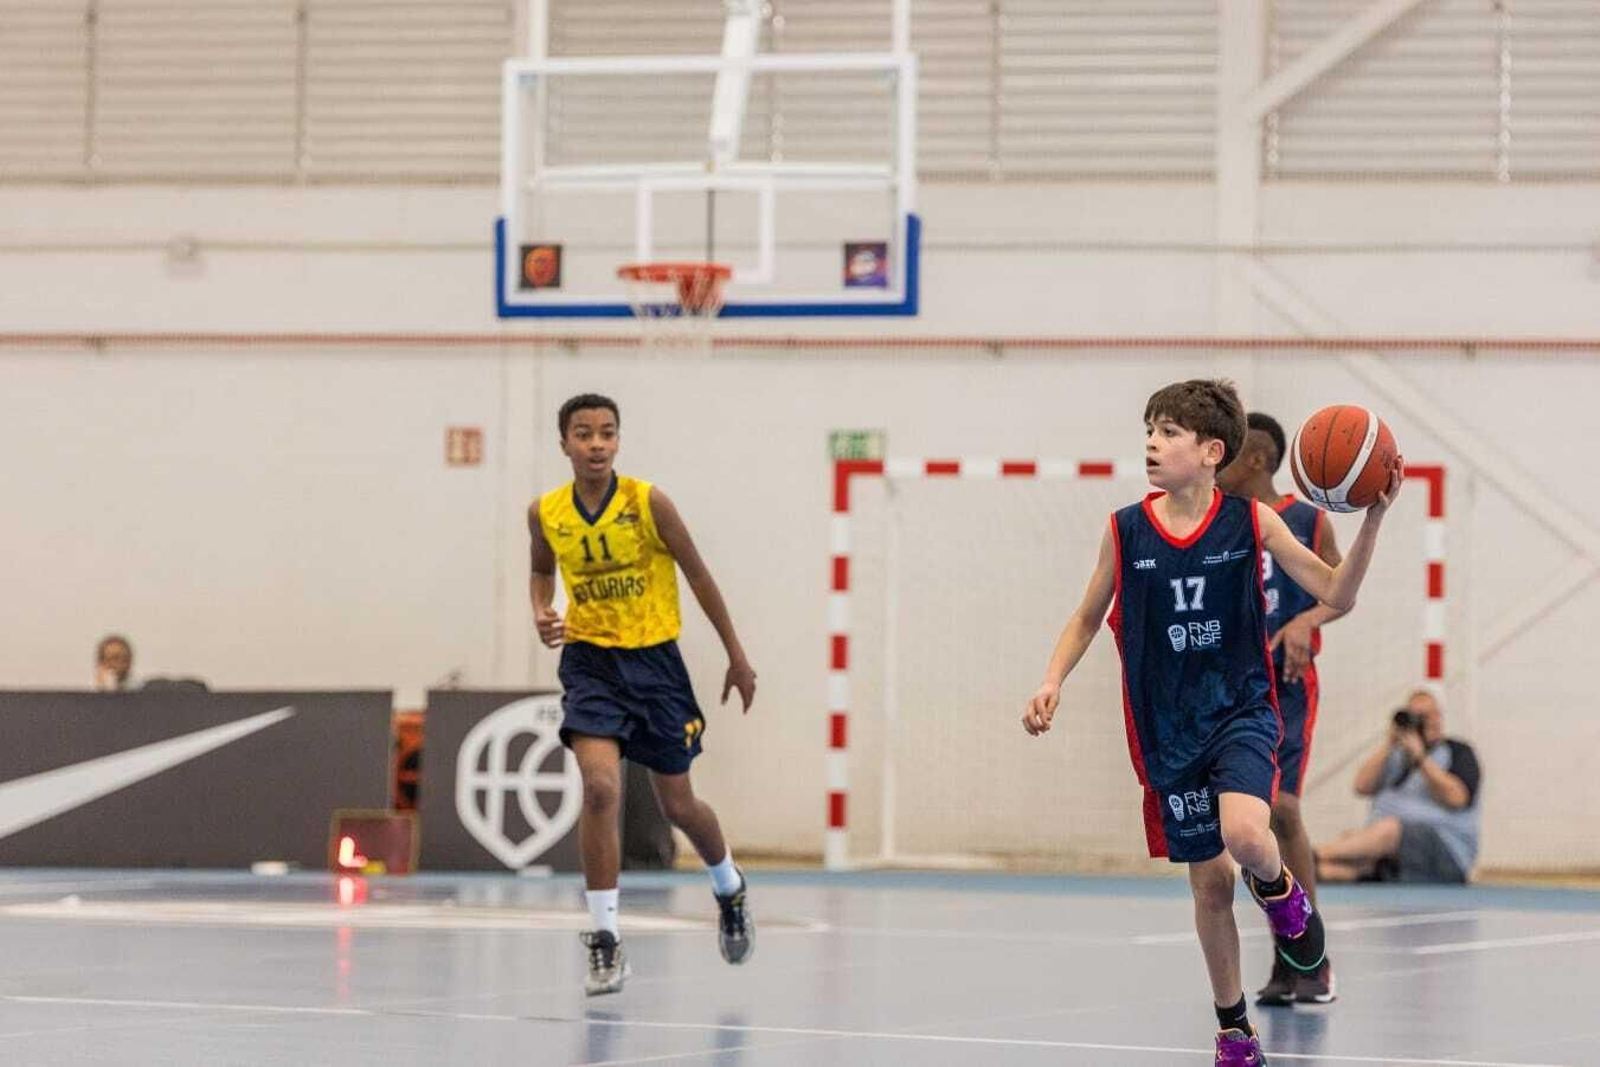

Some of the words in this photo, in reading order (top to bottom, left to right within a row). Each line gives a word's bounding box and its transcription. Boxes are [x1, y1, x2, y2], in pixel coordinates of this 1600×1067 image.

[580, 532, 612, 563] 11
[1169, 576, 1206, 613] 17
[1188, 619, 1221, 634] FNB
[1190, 632, 1222, 647] NSF
[1187, 798, 1211, 816] NS
